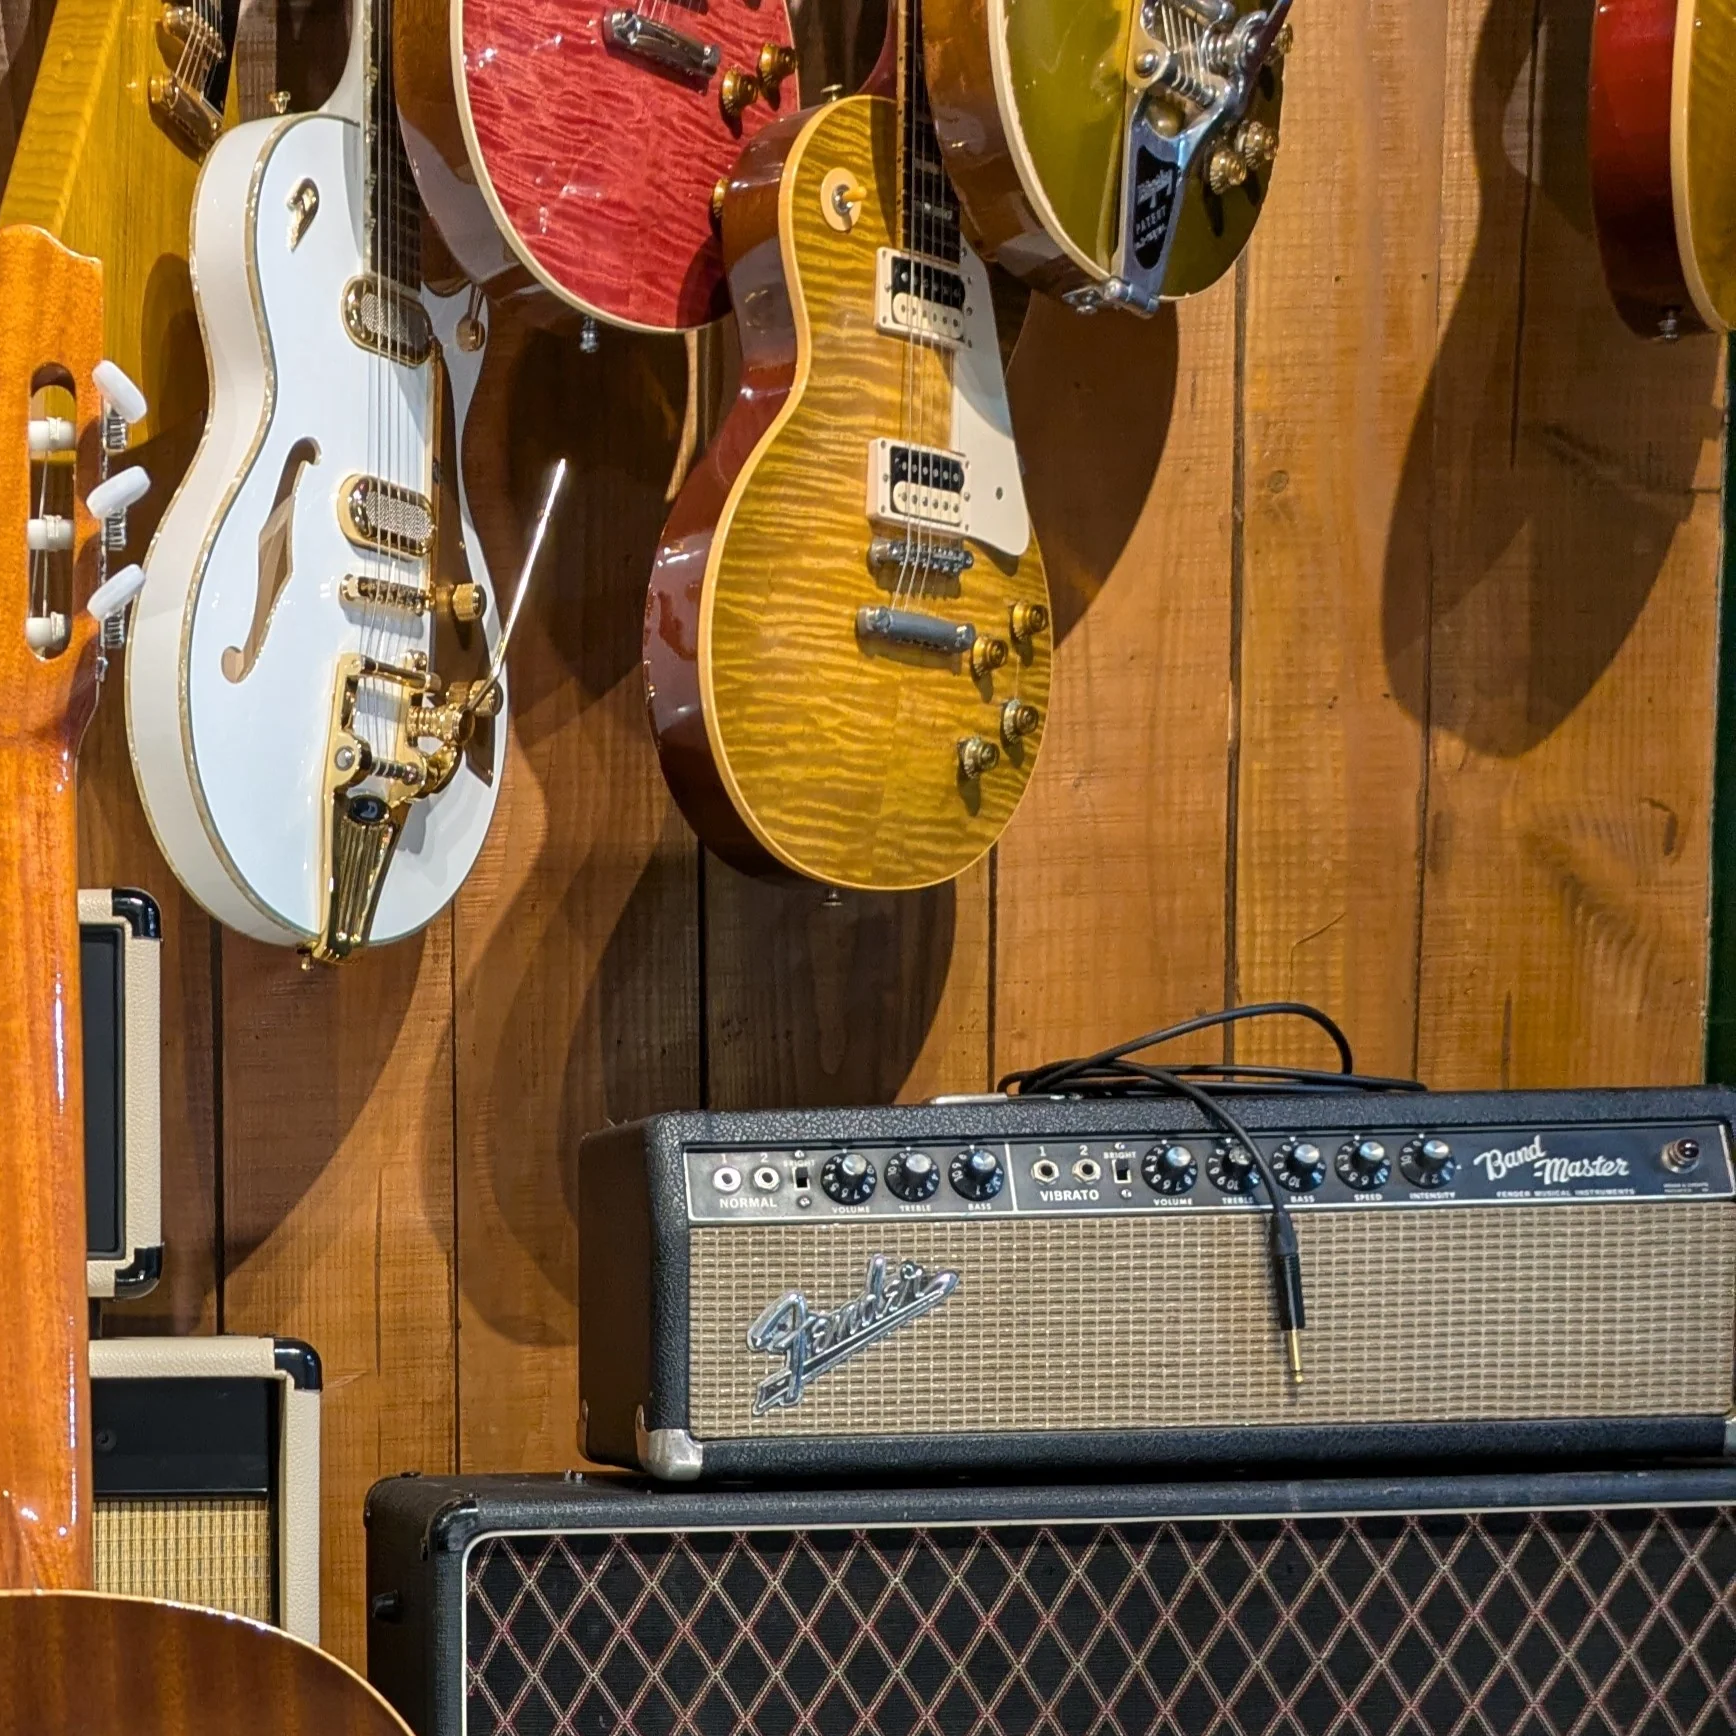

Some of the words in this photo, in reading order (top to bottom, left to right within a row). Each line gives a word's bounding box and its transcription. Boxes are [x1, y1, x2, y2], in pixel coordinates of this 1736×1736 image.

[1039, 1145, 1047, 1157] 1
[1079, 1144, 1089, 1156] 2
[1103, 1150, 1137, 1159] BRIGHT
[721, 1153, 728, 1164] 1
[760, 1152, 769, 1164] 2
[1473, 1134, 1546, 1181] Band
[783, 1158, 816, 1167] BRIGHT
[1039, 1189, 1100, 1202] VIBRATO
[1408, 1191, 1456, 1199] INTENSITY
[1496, 1189, 1531, 1198] FENDER
[1534, 1189, 1572, 1198] MUSICAL
[1574, 1187, 1637, 1196] INSTRUMENTS
[1153, 1197, 1193, 1206] VOLUME
[1221, 1196, 1254, 1204] TREBLE
[1290, 1194, 1315, 1203] BASS
[1353, 1193, 1383, 1202] SPEED
[719, 1197, 778, 1208] NORMAL
[968, 1202, 992, 1211] BASS
[831, 1205, 871, 1214] VOLUME
[899, 1204, 932, 1212] TREBLE
[746, 1252, 960, 1416] Fender
